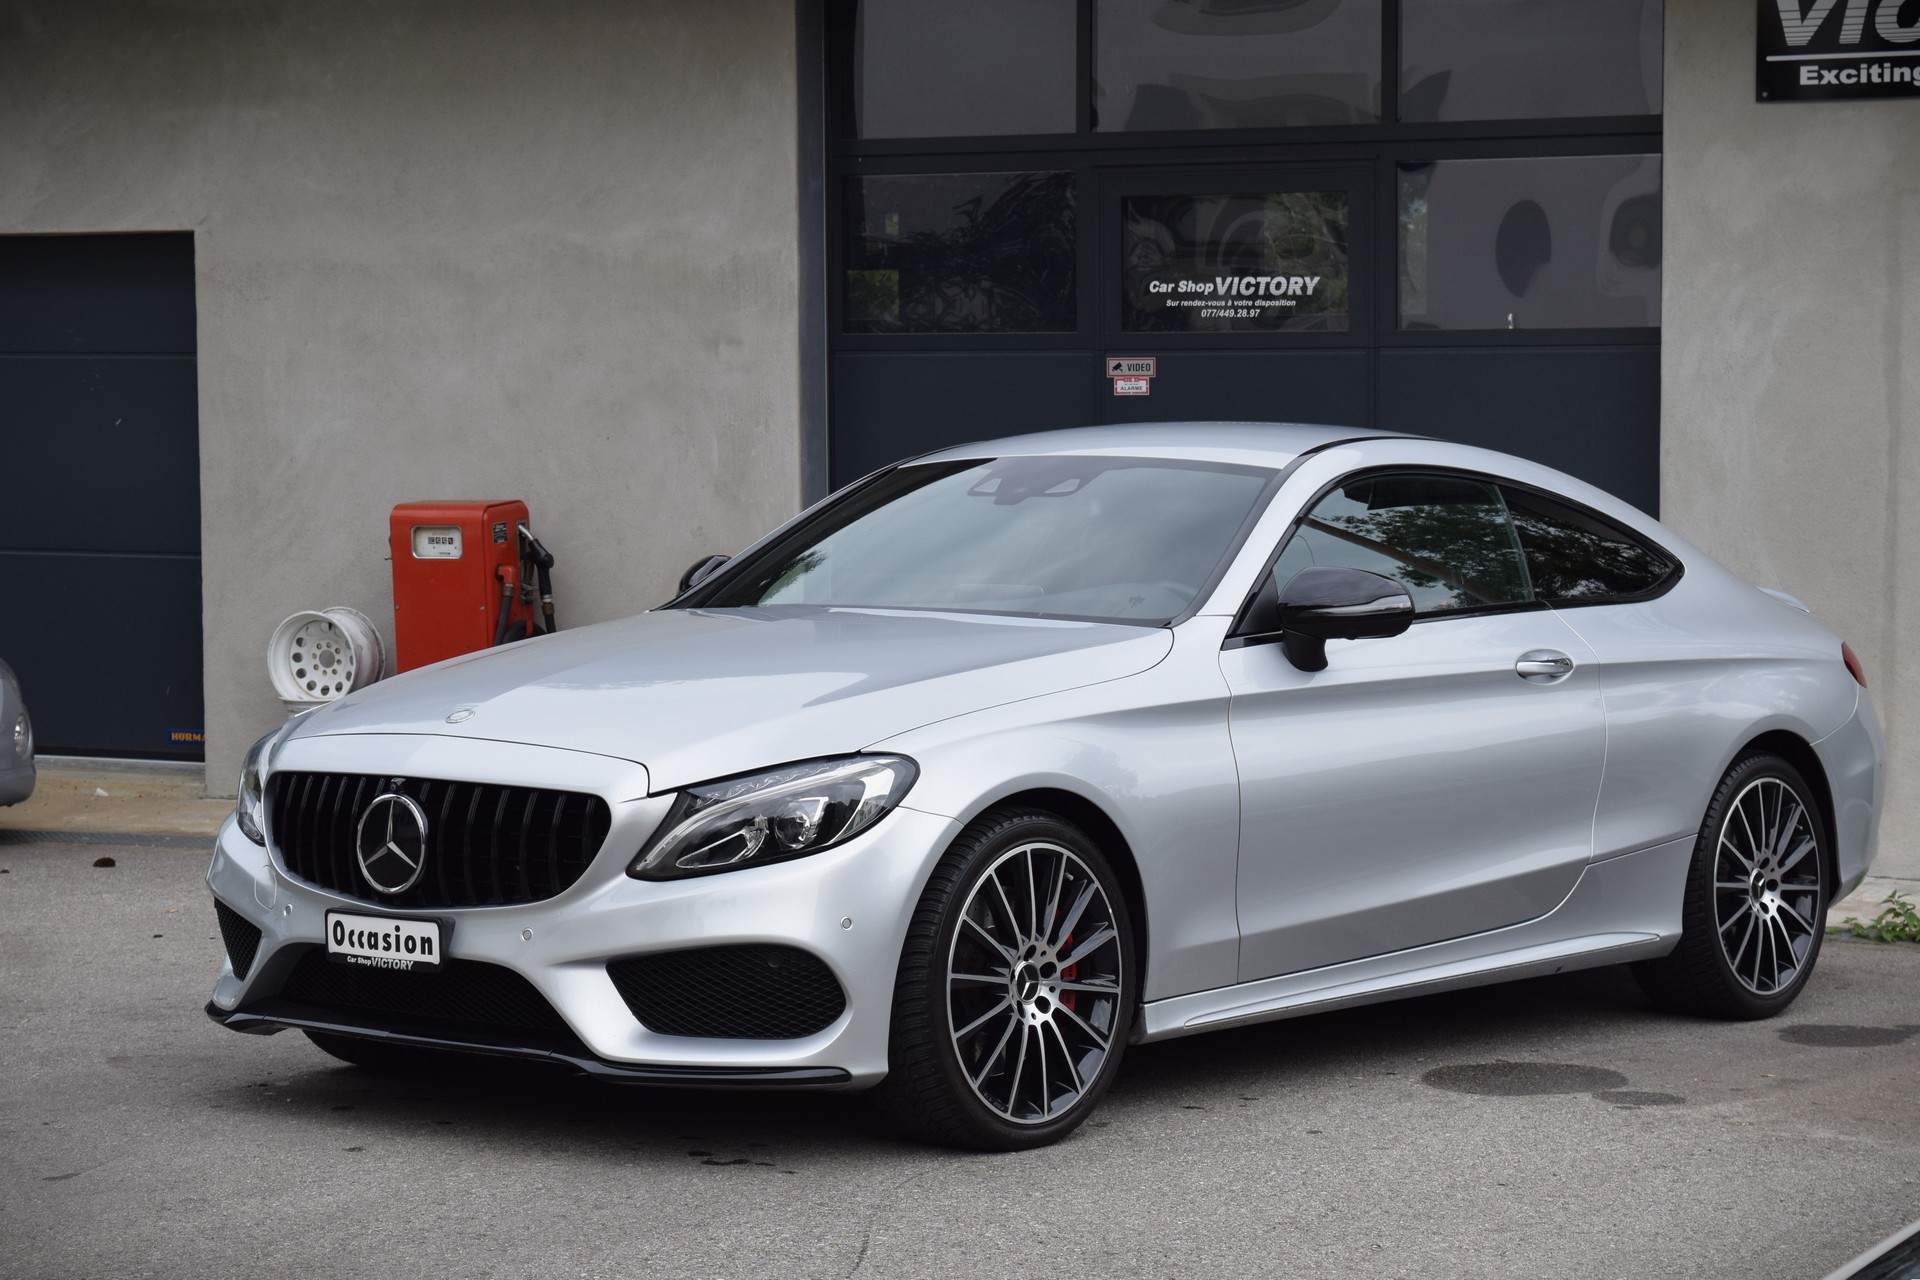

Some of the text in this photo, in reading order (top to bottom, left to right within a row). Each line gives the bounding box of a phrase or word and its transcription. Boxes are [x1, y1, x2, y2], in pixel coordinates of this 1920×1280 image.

[1149, 276, 1320, 296] Car Shop VICTORY
[1166, 299, 1180, 307] Sur
[1180, 299, 1225, 307] rendez-vous
[1227, 298, 1232, 307] à
[1254, 299, 1296, 308] disposition
[1201, 309, 1260, 318] 077/449.28.97
[1127, 363, 1151, 372] VIDEO
[333, 920, 433, 955] Occasion
[358, 957, 371, 966] Shop
[371, 957, 413, 970] VICTORY
